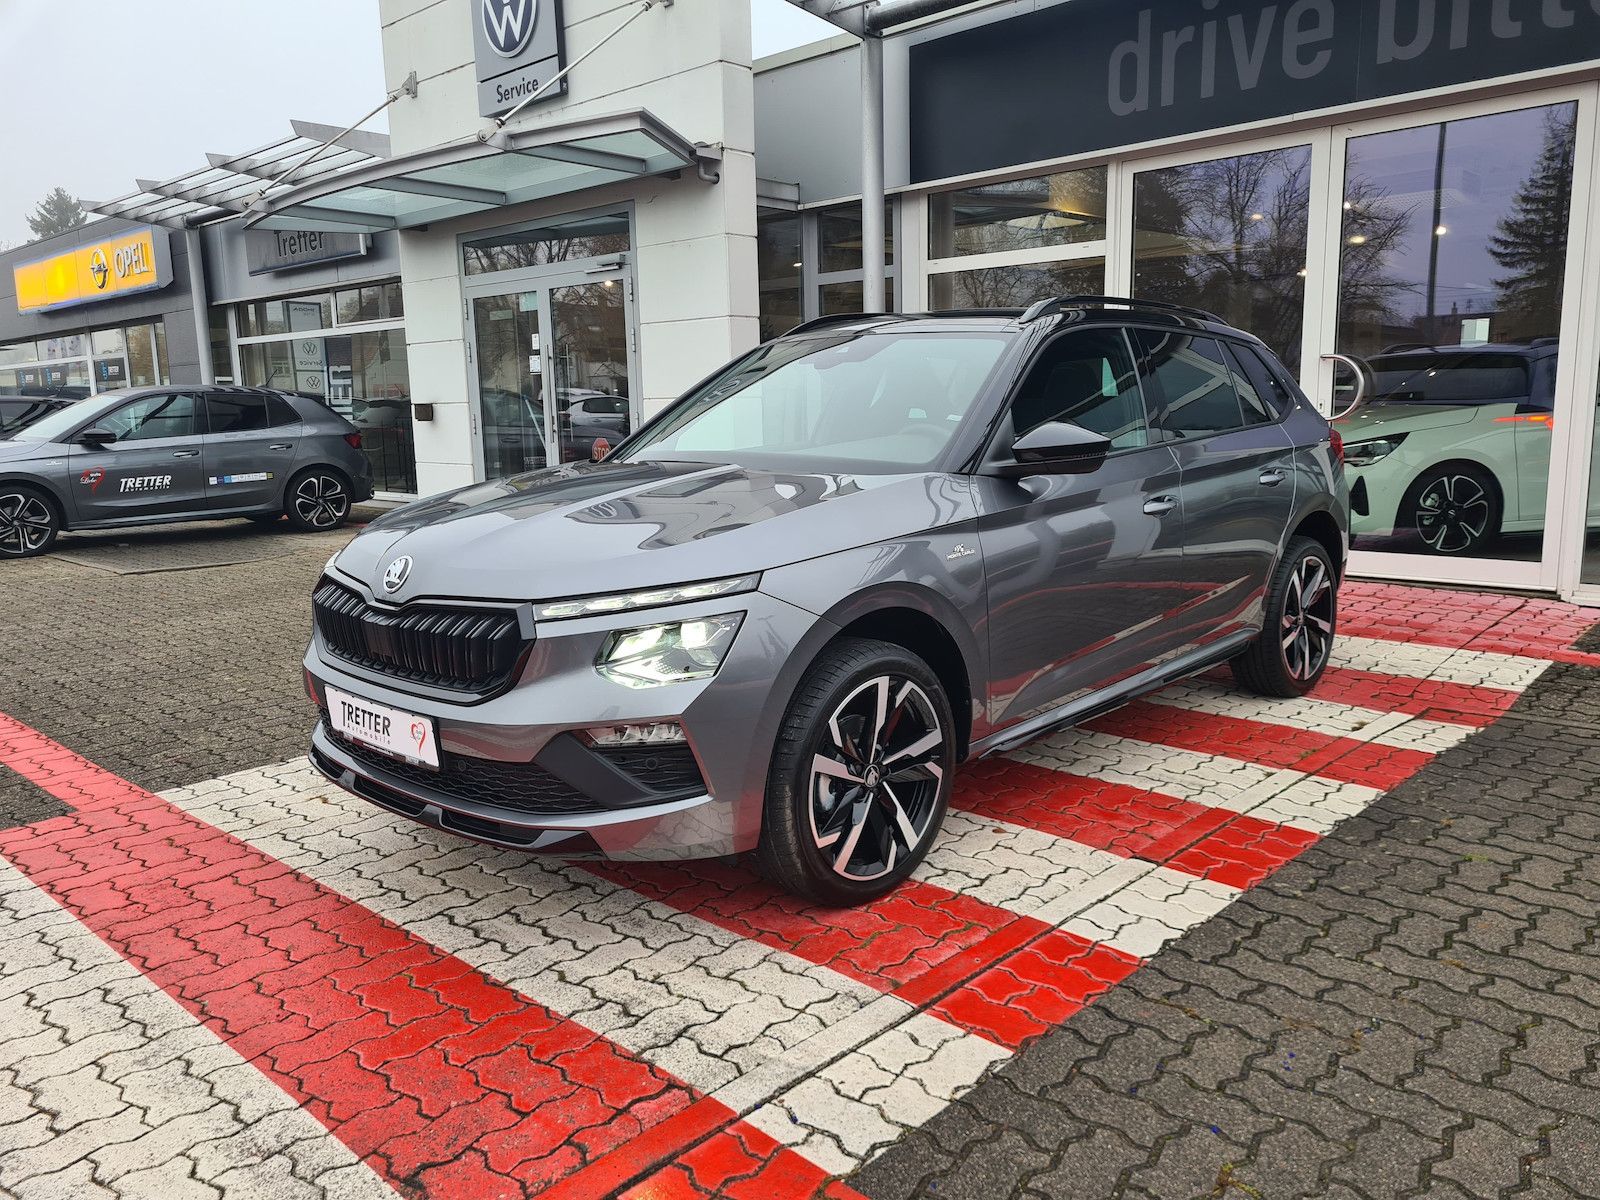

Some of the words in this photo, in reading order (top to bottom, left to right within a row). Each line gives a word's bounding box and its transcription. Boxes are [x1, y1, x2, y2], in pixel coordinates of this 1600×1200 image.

[1107, 0, 1335, 117] drive
[496, 77, 540, 104] Service
[273, 229, 324, 257] Tretter
[114, 243, 150, 278] OPEL
[120, 475, 172, 493] TRETTER
[341, 700, 391, 737] TRETTER
[347, 722, 391, 745] Automobile
